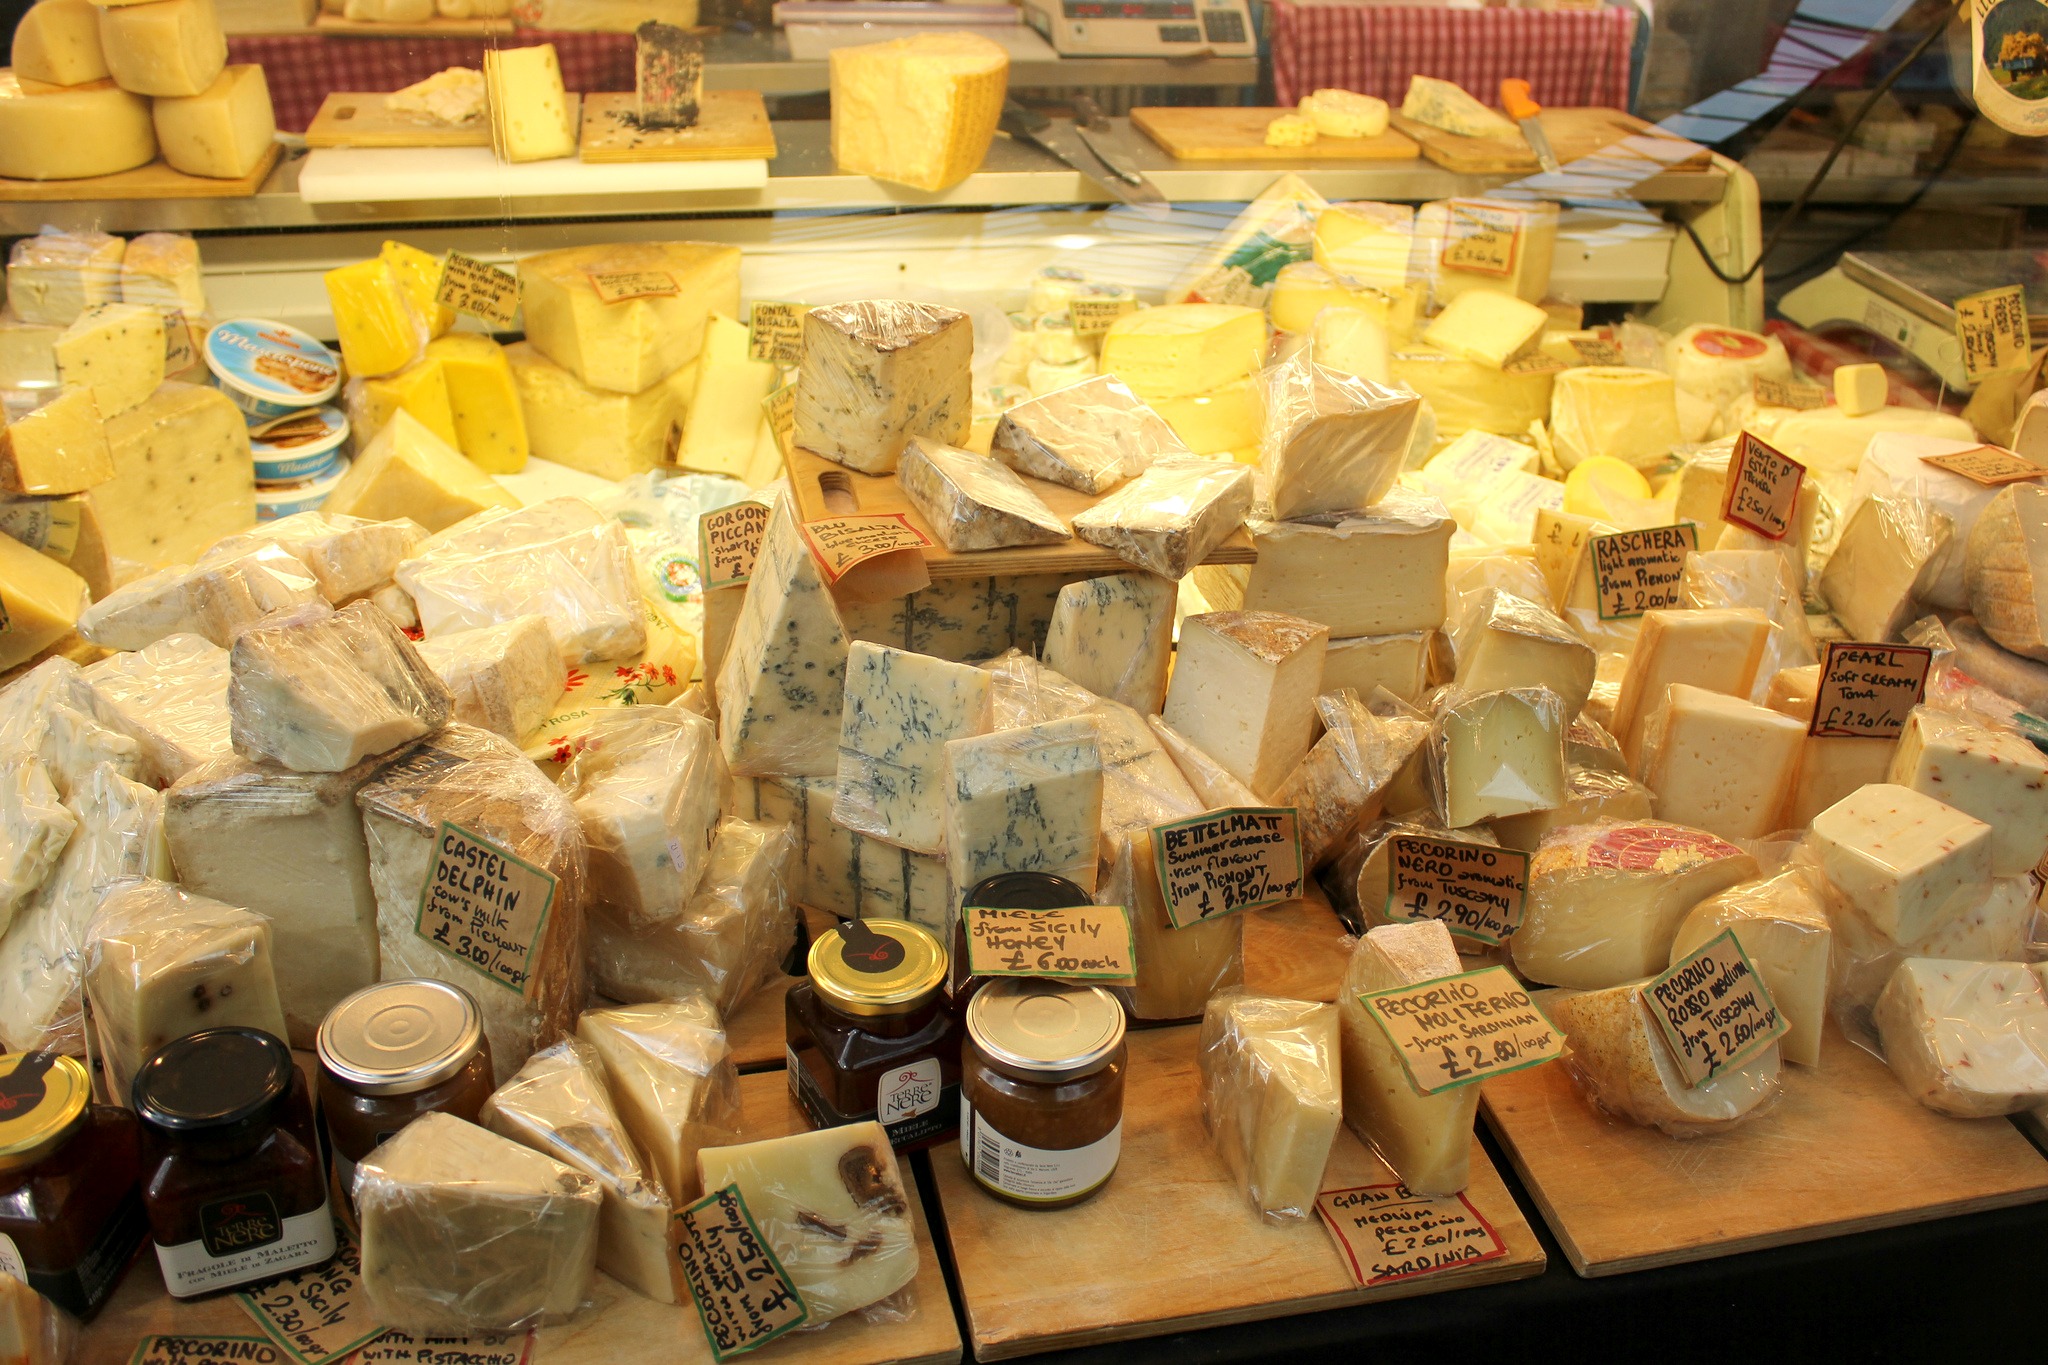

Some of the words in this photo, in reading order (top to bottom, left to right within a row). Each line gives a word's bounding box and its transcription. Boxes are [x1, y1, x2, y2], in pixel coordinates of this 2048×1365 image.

[755, 306, 795, 317] FONTAL
[756, 317, 799, 328] BISALTA
[218, 330, 337, 374] Mascarpone
[707, 507, 769, 530] GORGON
[711, 519, 766, 544] PICCAN
[811, 522, 846, 534] BLU
[819, 524, 906, 541] BISALTA
[1596, 530, 1686, 558] RASCHERA
[836, 552, 853, 568] £
[1600, 575, 1633, 595] from
[1635, 566, 1684, 587] PIEMON
[1612, 592, 1630, 614] £
[1837, 651, 1904, 669] PEARL
[1165, 815, 1282, 851] BETTELMATT
[443, 835, 509, 882] CASTEL
[1396, 840, 1497, 867] PECORINO
[1398, 855, 1453, 877] NERO
[437, 860, 521, 911] DELPHIN
[1170, 881, 1200, 907] from
[1398, 873, 1433, 890] from
[427, 896, 463, 925] from
[978, 909, 1065, 920] MIELE
[1198, 891, 1215, 918] £
[1404, 892, 1430, 919] £
[433, 922, 451, 946] £
[973, 921, 1022, 937] from
[986, 935, 1066, 950] HONEY
[1001, 950, 1032, 970] £
[1654, 957, 1715, 1010] PECORINO
[1667, 989, 1710, 1032] ROSSO
[1709, 960, 1750, 1000] medium
[1375, 982, 1479, 1019] PECORINO
[1414, 991, 1531, 1032] MOLITERNO
[1458, 1011, 1539, 1039] SARDINIAN
[1680, 1028, 1708, 1058] from
[1440, 1045, 1472, 1079] £
[1702, 1041, 1721, 1078] £
[892, 1120, 929, 1137] MIELE
[1333, 1191, 1390, 1210] GRAN
[1375, 1215, 1465, 1242] PECORINO
[177, 1259, 236, 1280] FRAGOLE
[256, 1239, 318, 1258] MALETTO
[211, 1265, 248, 1279] MIELE
[264, 1249, 310, 1265] ZAGARA
[681, 1210, 724, 1292] WALNUTS
[1372, 1244, 1482, 1279] SARDINIA
[679, 1242, 736, 1350] PECORINO
[762, 1278, 798, 1312] £
[740, 1293, 773, 1339] from
[152, 1336, 277, 1364] PECORINO
[363, 1349, 413, 1360] WITH
